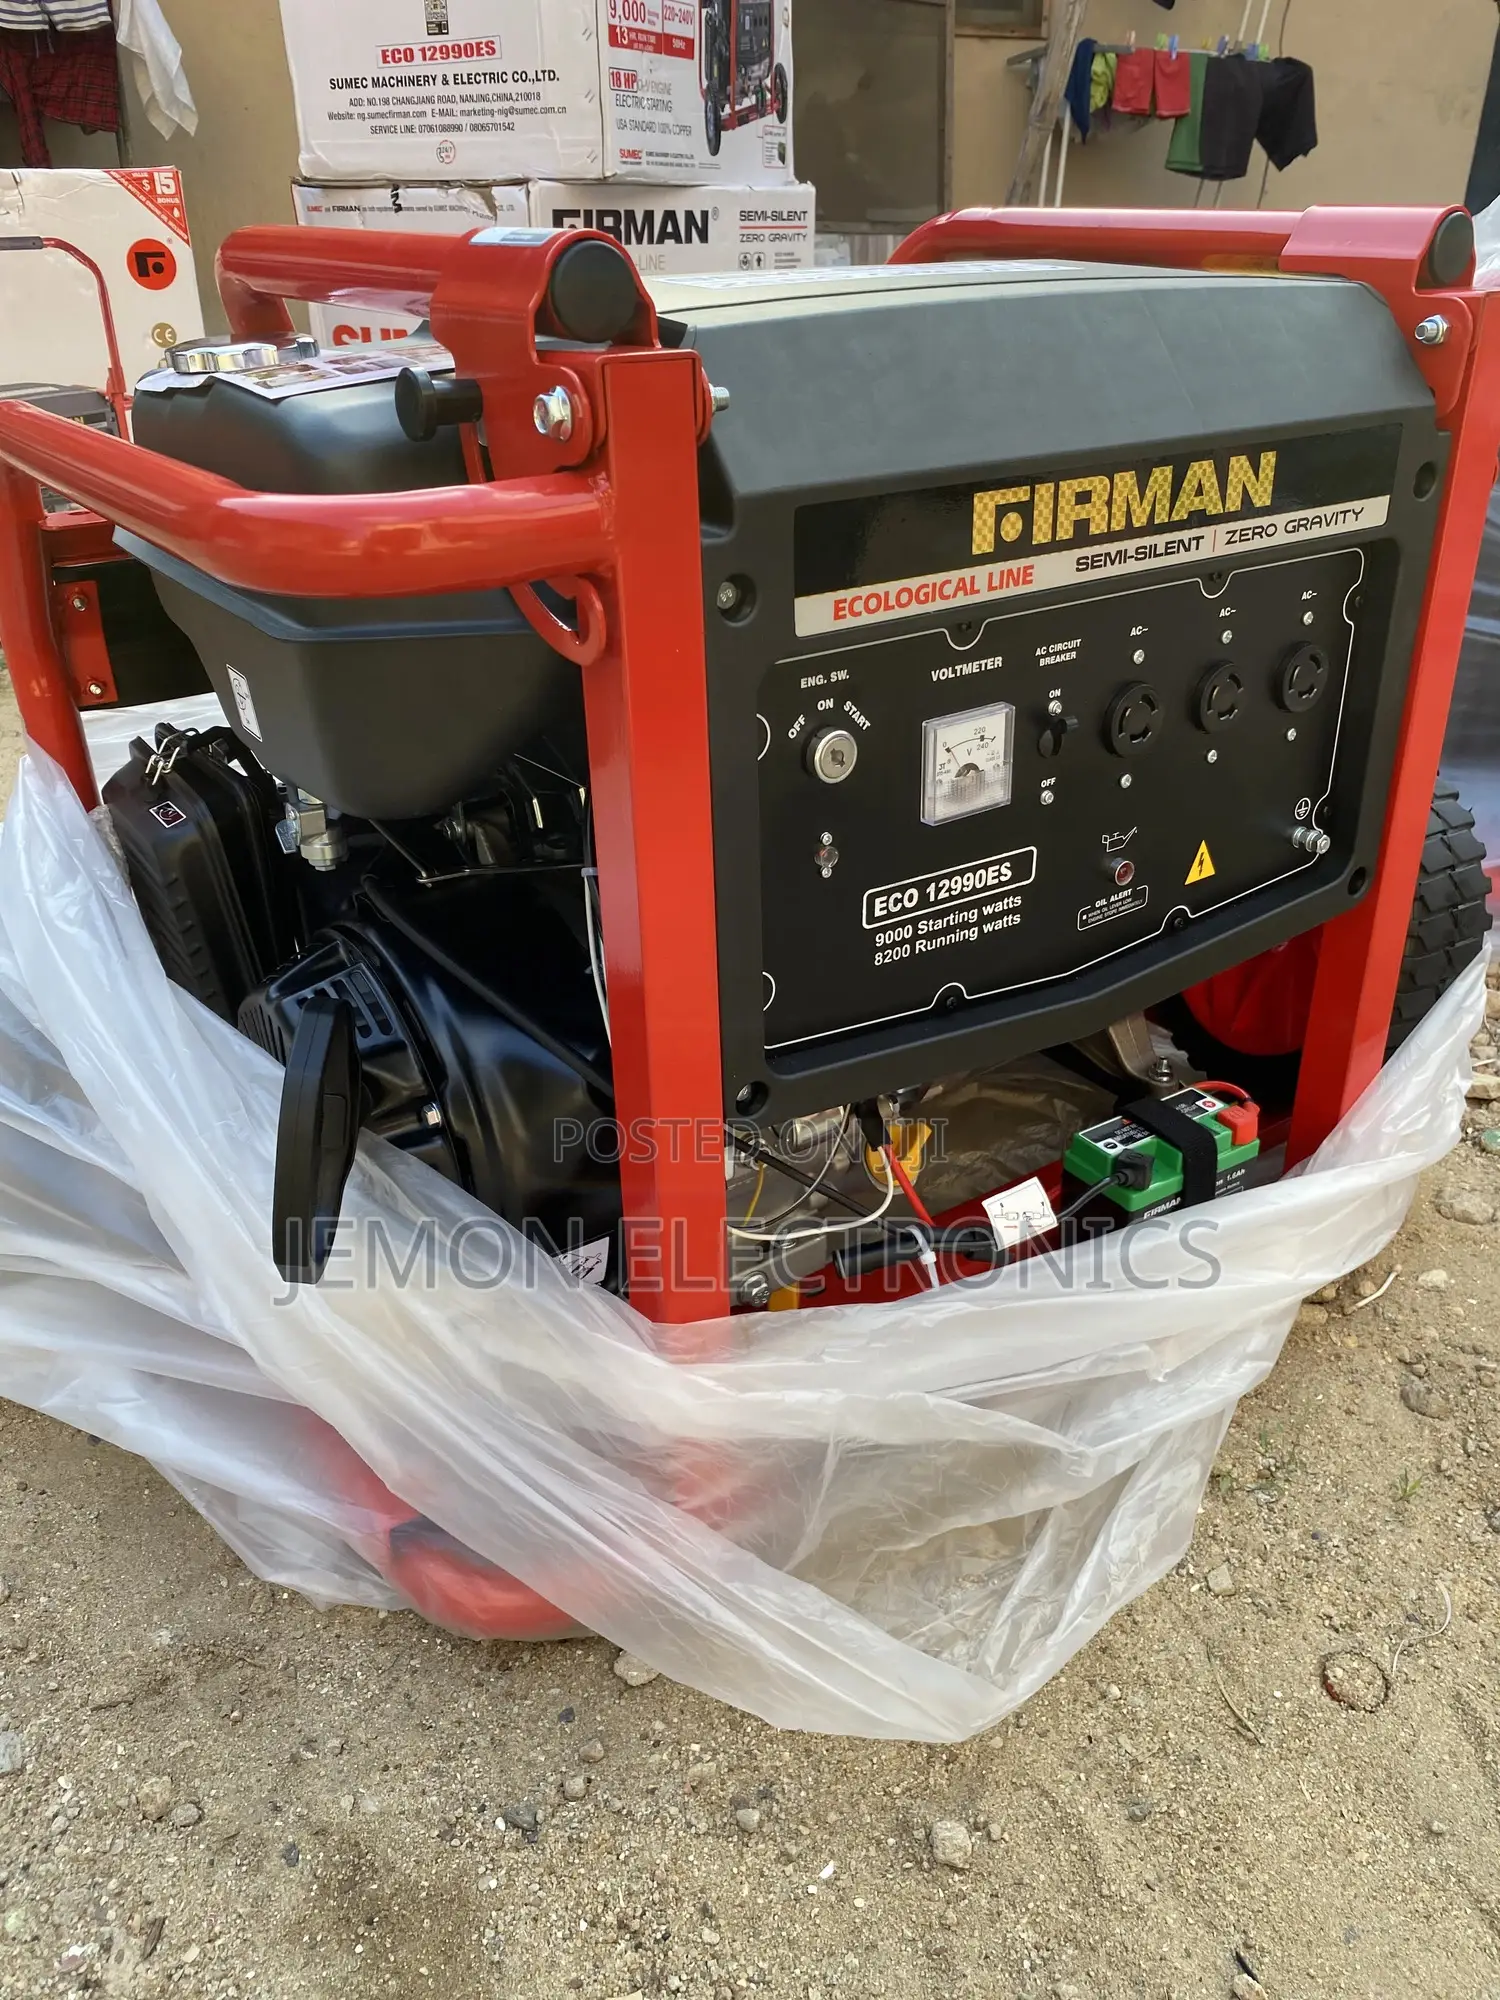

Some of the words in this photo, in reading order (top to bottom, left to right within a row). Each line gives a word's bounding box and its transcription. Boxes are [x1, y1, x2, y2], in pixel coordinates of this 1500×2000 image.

[609, 0, 646, 23] 9,000
[615, 26, 629, 45] 13
[381, 47, 415, 65] ECO
[418, 40, 497, 62] 12990ES
[330, 77, 369, 90] SUMEC
[371, 74, 437, 88] MACHINERY
[441, 73, 450, 86] &
[453, 71, 508, 85] ELECTRIC
[512, 69, 560, 85] CO.,LTD.
[610, 71, 622, 88] 18
[623, 72, 638, 90] HP
[349, 97, 365, 107] ADD:
[366, 96, 391, 106] NO.198
[391, 95, 436, 106] CHANGJIANG
[437, 94, 458, 105] ROAD,
[615, 93, 646, 110] ELECTRIC
[646, 97, 673, 113] STARTING
[327, 110, 356, 121] Website:
[356, 109, 427, 122] ng.sumecfirman.com
[431, 108, 458, 118] E-MAIL:
[459, 105, 567, 118] marketing-nig@sumec.com.cn
[370, 125, 398, 135] SERVICE
[399, 124, 417, 134] LINE:
[418, 123, 463, 134] 07061088990
[464, 123, 468, 132] /
[469, 121, 515, 132] 08065701542
[616, 118, 628, 131] USA
[628, 119, 657, 134] STANDARD
[672, 123, 692, 137] COPPER
[619, 149, 643, 160] SUMEC
[141, 179, 151, 192] $
[153, 171, 176, 195] 15
[332, 205, 361, 213] FIRMAN
[739, 210, 808, 222] SEMI-SILENT
[739, 233, 766, 243] ZERO
[768, 233, 808, 243] GRAVITY
[972, 450, 1277, 556] FIRMAN
[1225, 522, 1278, 546] ZERO
[1284, 507, 1365, 536] GRAVITY
[1075, 535, 1205, 573] SEMI-SILENT
[832, 574, 982, 622] ECOLOGICAL
[986, 564, 1035, 591] LINE
[1035, 645, 1047, 657] AC
[1048, 638, 1082, 654] CIRCUIT
[1039, 651, 1077, 667] BREAKER
[800, 674, 828, 689] ENG.
[830, 668, 850, 683] SW.
[931, 656, 1003, 682] VOLTMETER
[1048, 688, 1061, 699] ON
[817, 697, 834, 712] ON
[843, 700, 871, 731] START
[788, 714, 807, 740] OFF
[973, 726, 986, 736] 220
[966, 748, 973, 756] V
[976, 741, 989, 751] 240
[1041, 777, 1056, 788] OFF
[874, 887, 919, 917] ECO
[925, 862, 1012, 902] 12990ES
[1095, 898, 1107, 908] OIL
[1109, 888, 1133, 903] ALERT
[875, 925, 913, 947] 9000
[917, 906, 978, 935] Starting
[982, 893, 1022, 917] watts
[1088, 909, 1101, 918] WHEN
[1088, 914, 1104, 924] ENGINE
[874, 943, 911, 967] 8200
[915, 925, 979, 954] Running
[982, 912, 1021, 936] watts
